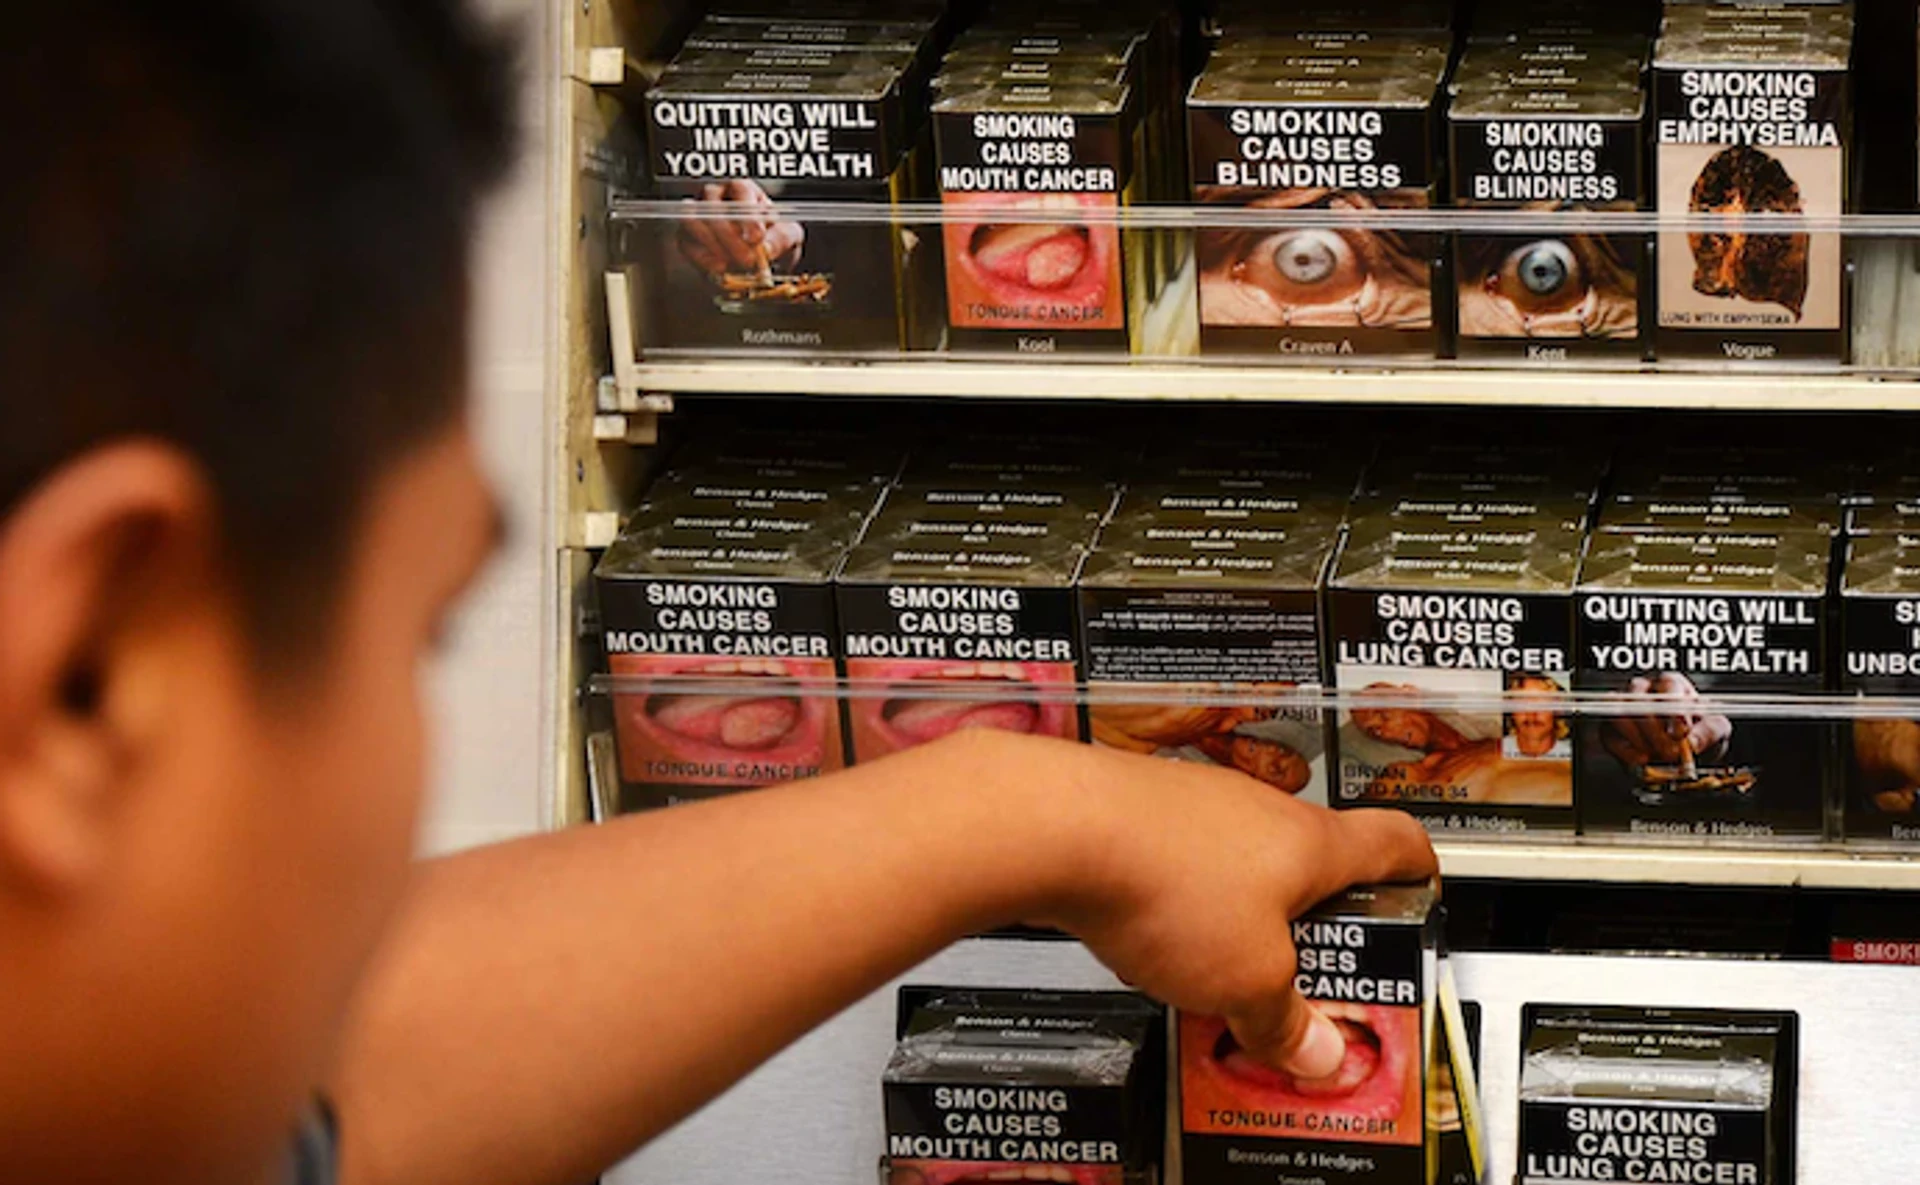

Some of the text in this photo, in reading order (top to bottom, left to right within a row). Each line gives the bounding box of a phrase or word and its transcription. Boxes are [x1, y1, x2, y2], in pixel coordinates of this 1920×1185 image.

[1681, 72, 1816, 97] SMOKING
[654, 103, 876, 127] QUITTING WILL
[1690, 97, 1807, 122] CAUSES
[974, 115, 1075, 138] SMOKING
[1230, 109, 1382, 135] SMOKING
[1659, 120, 1839, 146] EMPHYSEMA
[694, 128, 830, 152] IMPROVE
[1486, 122, 1604, 147] SMOKING
[982, 142, 1071, 164] CAUSES
[1242, 137, 1374, 161] CAUSES
[664, 152, 873, 177] YOUR HEALTH
[1494, 150, 1596, 174] CAUSES
[941, 167, 1115, 191] MOUTH CANCER
[1218, 162, 1401, 188] BLINDNESS
[1474, 175, 1618, 199] BLINDNESS
[968, 305, 1103, 321] TONGUE CANCER
[742, 328, 822, 346] Rothmans
[1018, 337, 1056, 352] Kool
[1280, 337, 1353, 354] Craven A
[1528, 346, 1566, 360] Kent
[1723, 342, 1775, 358] Vogue
[646, 584, 777, 608] SMOKING
[888, 586, 1020, 610] SMOKING
[1378, 594, 1524, 622] SMOKING
[658, 610, 772, 633] CAUSES
[1584, 597, 1815, 624] QUITTING WILL
[900, 612, 1014, 635] CAUSES
[1388, 620, 1515, 645] CAUSES
[1625, 623, 1765, 648] IMPROVE
[606, 632, 828, 656] MOUTH CANCER
[846, 636, 1072, 660] MOUTH CANCER
[1339, 641, 1425, 666] LUNG
[1434, 646, 1564, 670] CANCER
[1591, 646, 1809, 673] YOUR HEALTH
[646, 761, 818, 779] TONGUE CANCER
[1344, 764, 1407, 780] BRYAN
[1449, 816, 1462, 828] &
[1466, 816, 1526, 832] Hedges
[1630, 819, 1773, 838] Benson & Hedges
[1294, 923, 1365, 947] KING
[1300, 949, 1357, 973] SES
[1294, 974, 1416, 1003] CANCER
[935, 1087, 1068, 1112] SMOKING
[945, 1113, 1061, 1136] CAUSES
[1208, 1110, 1395, 1135] TONGUE CANCER
[1568, 1108, 1717, 1136] SMOKING
[890, 1136, 1118, 1161] MOUTH CANCER
[1577, 1133, 1708, 1159] CAUSES
[1228, 1149, 1375, 1172] Benson & Hedges
[1528, 1154, 1758, 1184] LUNG CANCER
